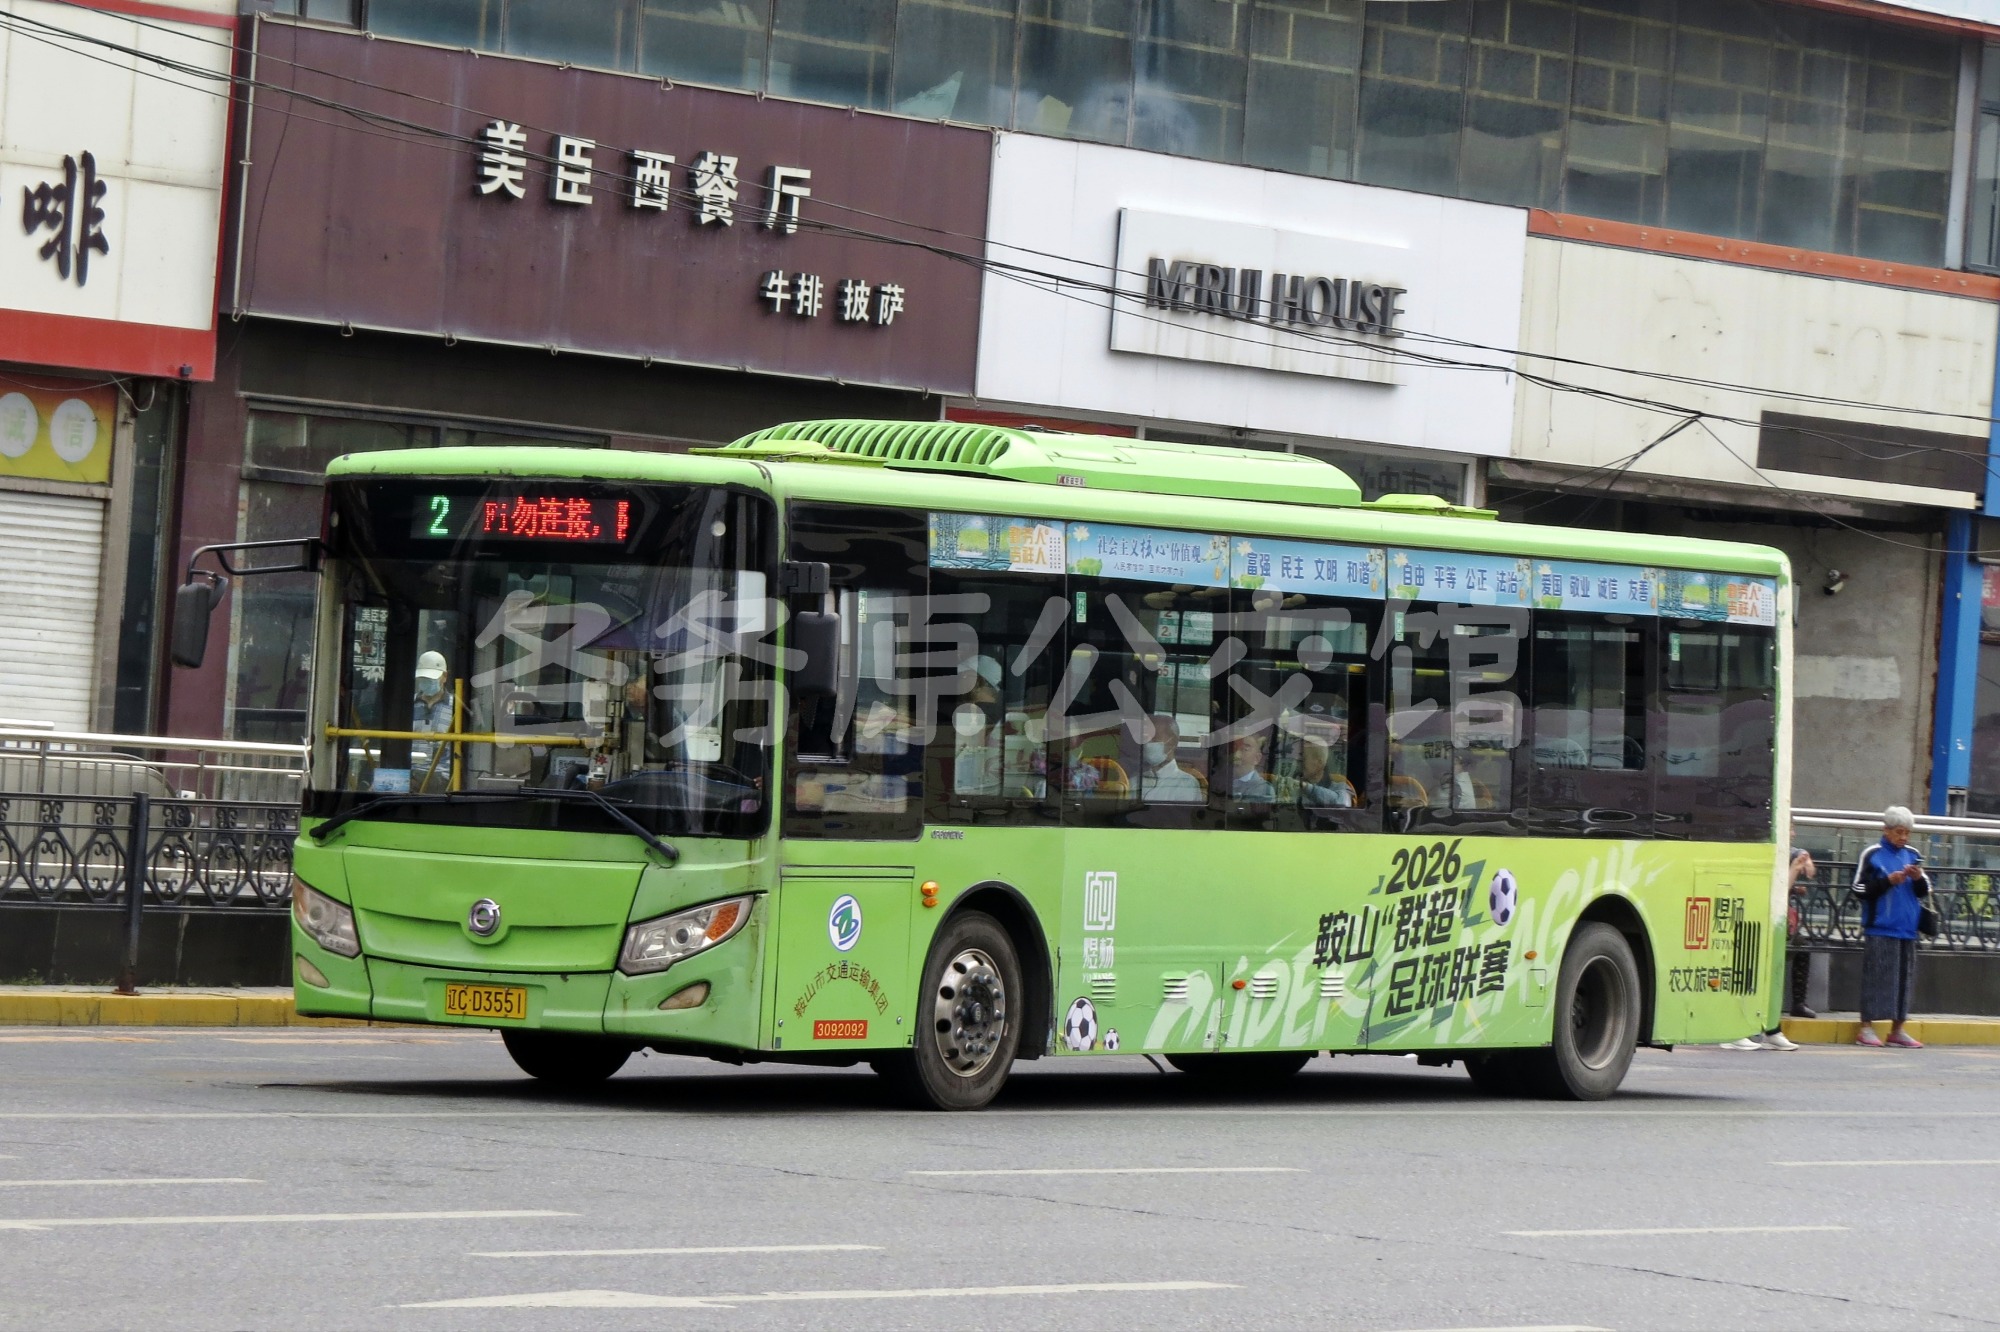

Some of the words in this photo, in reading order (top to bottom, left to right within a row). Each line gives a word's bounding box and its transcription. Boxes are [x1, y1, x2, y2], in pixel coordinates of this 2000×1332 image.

[477, 120, 811, 234] 美臣西餐厅
[23, 150, 109, 287] 啡
[762, 269, 823, 318] 牛排
[840, 279, 905, 325] 披萨
[1146, 257, 1262, 321] MERUI
[1270, 273, 1408, 338] HOUSE
[429, 495, 450, 534] 2
[1097, 534, 1202, 564] 社会主义核心价值观
[1247, 552, 1271, 577] 富强
[1281, 555, 1304, 581] 民主
[1314, 558, 1338, 583] 文明
[1347, 560, 1371, 585] 和谐
[1403, 562, 1425, 587] 自由
[1434, 565, 1457, 590] 平等
[1465, 567, 1488, 591] 公正
[1496, 569, 1518, 594] 法治
[1541, 573, 1563, 597] 爱国
[1570, 575, 1591, 599] 敬业
[1598, 577, 1619, 600] 诚信
[1627, 579, 1649, 602] 友善
[1385, 838, 1463, 895] 2026
[794, 960, 889, 1019] 鞍山市交通运输集团
[1384, 940, 1511, 1018] 足球联赛
[817, 1023, 865, 1037] 3092092
